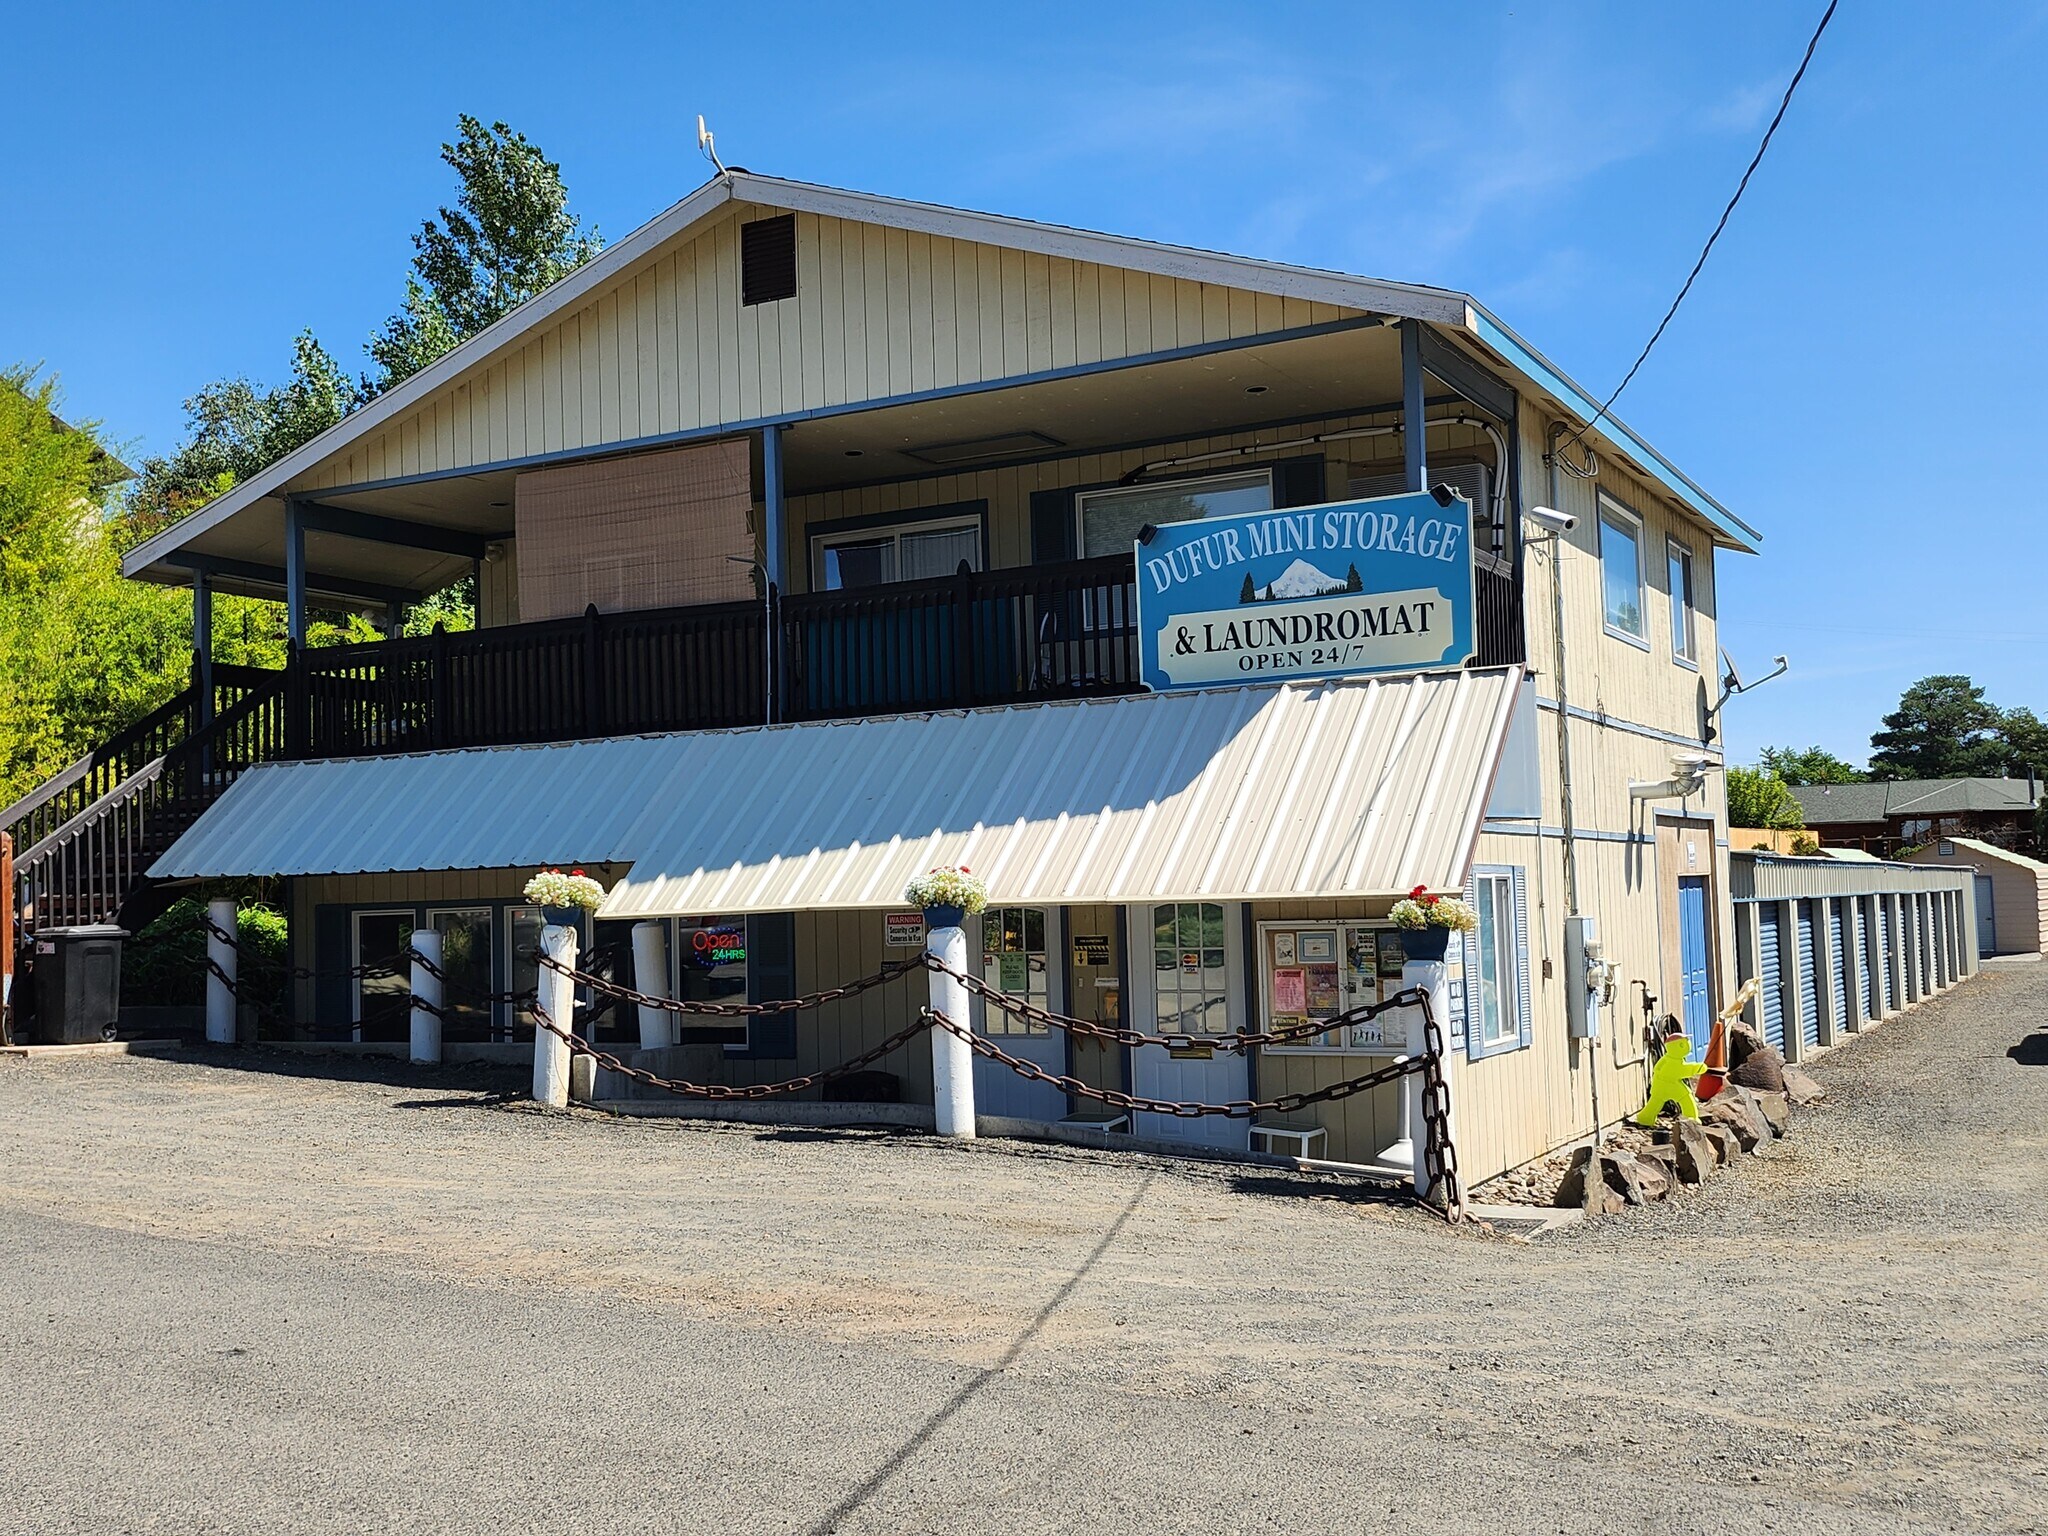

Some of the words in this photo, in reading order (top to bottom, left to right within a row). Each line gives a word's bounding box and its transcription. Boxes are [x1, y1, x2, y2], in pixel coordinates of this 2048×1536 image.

[1145, 527, 1245, 595] DUFUR
[1245, 513, 1317, 560] MINI
[1321, 511, 1464, 564] STORAGE
[1174, 625, 1197, 656] &
[1202, 601, 1435, 653] LAUNDROMAT
[1238, 650, 1304, 672] OPEN
[1310, 643, 1365, 666] 24/7
[888, 915, 922, 925] WARNING
[889, 926, 908, 935] Security
[692, 930, 741, 954] Open
[711, 948, 746, 961] 24HRS
